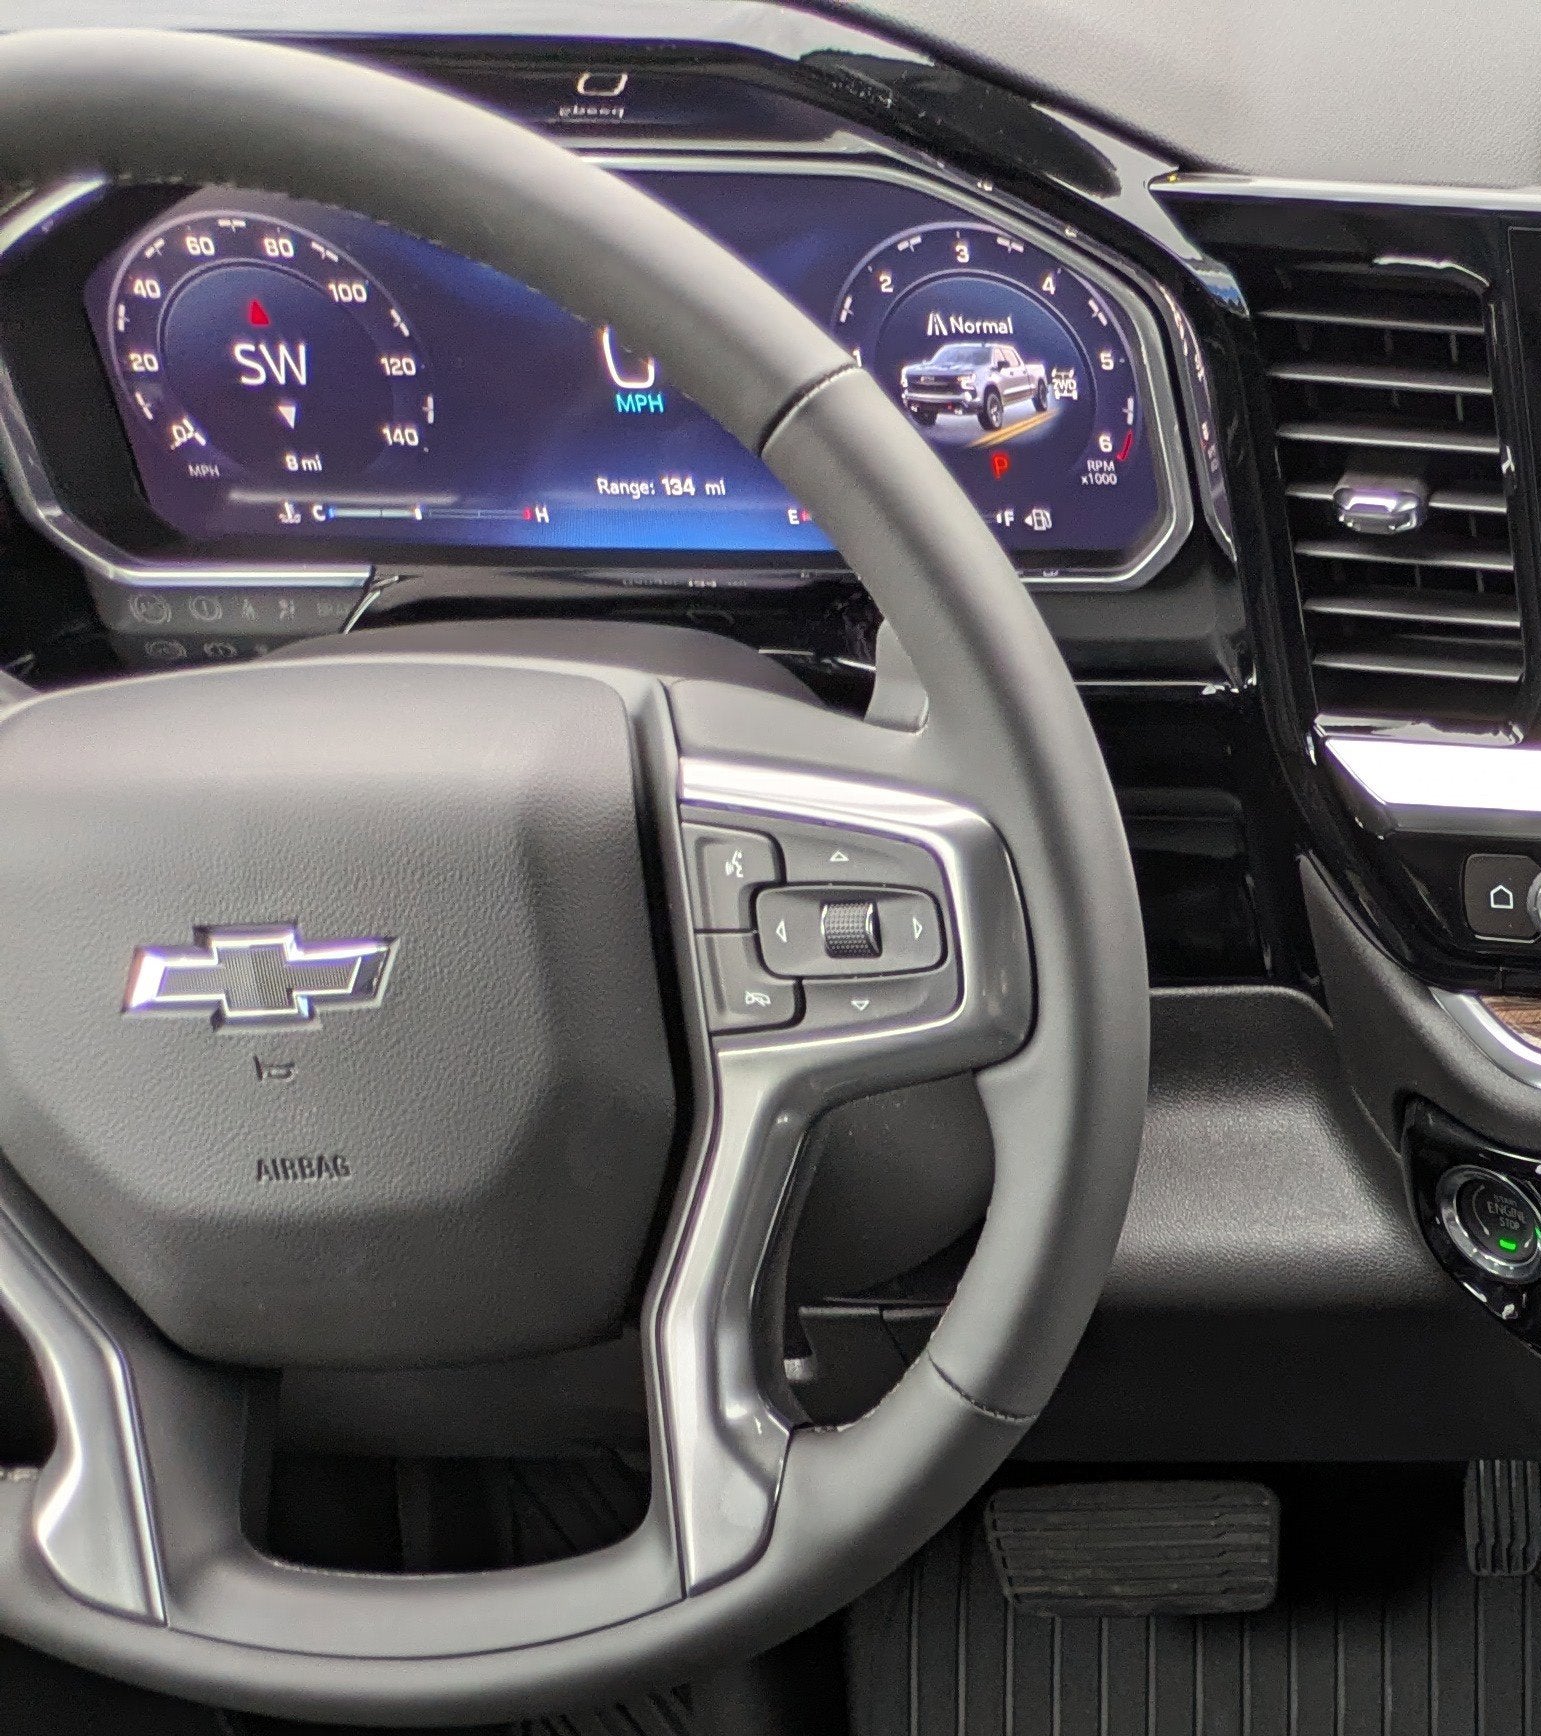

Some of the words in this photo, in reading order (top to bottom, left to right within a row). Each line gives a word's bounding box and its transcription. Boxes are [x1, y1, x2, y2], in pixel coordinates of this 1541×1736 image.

[186, 236, 216, 257] 60
[262, 237, 295, 258] 80
[955, 244, 970, 263] 3
[132, 278, 162, 299] 40
[329, 281, 368, 303] 100
[878, 273, 894, 294] 2
[1041, 275, 1056, 295] 4
[948, 315, 1014, 335] Normal
[128, 352, 159, 373] 20
[233, 342, 308, 387] SW
[380, 355, 417, 378] 120
[851, 347, 863, 368] 1
[1099, 351, 1115, 371] 5
[614, 392, 665, 414] MPH
[381, 426, 419, 447] 140
[1098, 434, 1113, 453] 6
[188, 463, 221, 478] MPH
[284, 454, 299, 472] 8
[301, 454, 323, 472] mi
[991, 454, 1008, 479] P
[1086, 459, 1116, 472] RPM
[596, 477, 656, 500] Range:
[661, 477, 696, 497] 134
[705, 477, 726, 496] mi
[1080, 472, 1118, 485] x1000
[312, 504, 326, 522] C
[534, 505, 549, 524] H
[787, 508, 800, 525] E
[1003, 509, 1015, 527] F
[255, 1154, 351, 1182] AIRBAG
[1498, 1216, 1521, 1230] STOP
